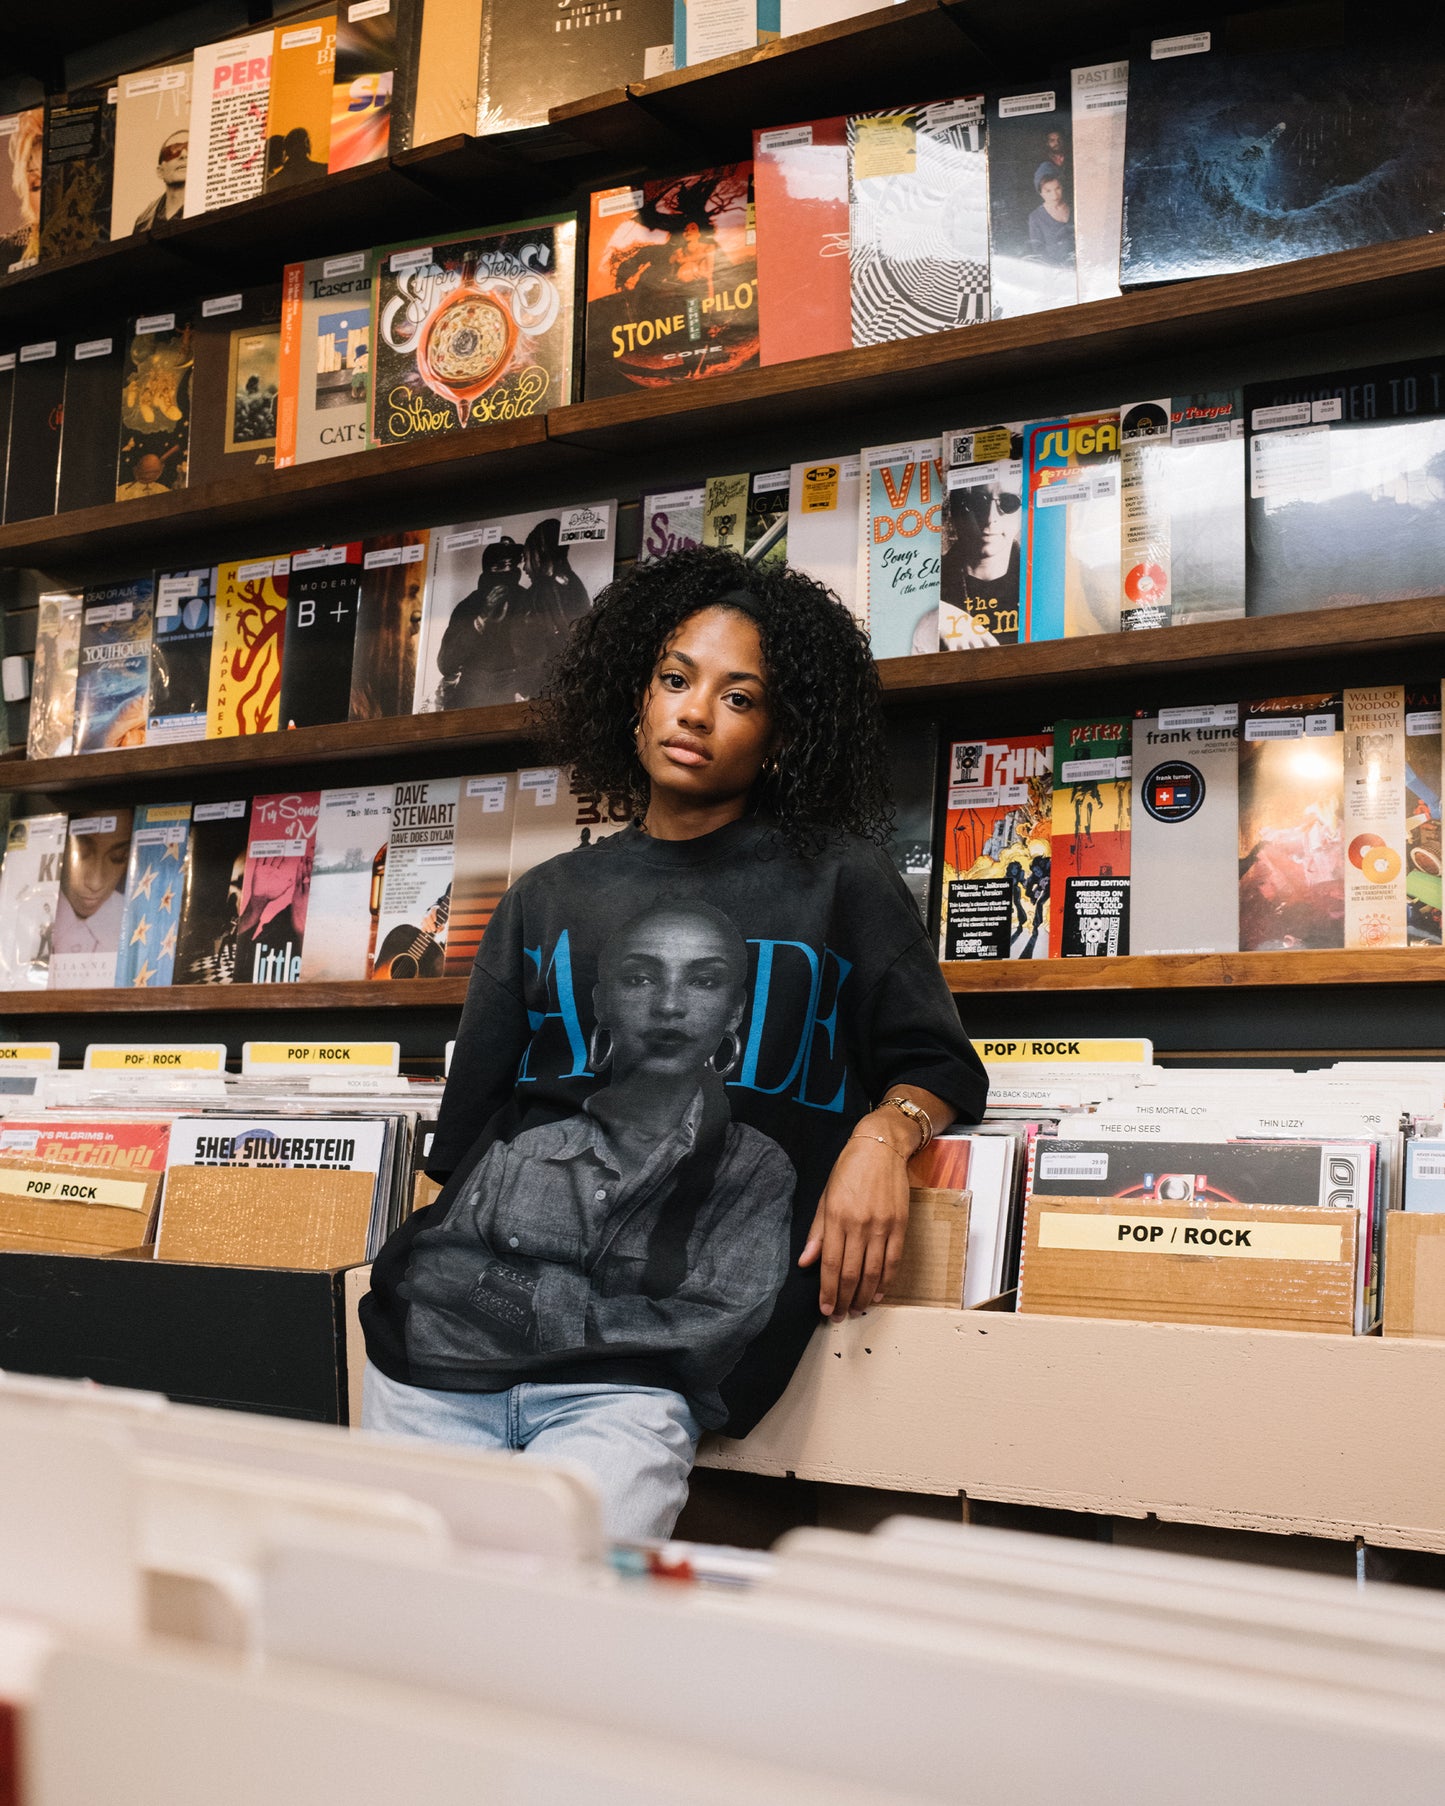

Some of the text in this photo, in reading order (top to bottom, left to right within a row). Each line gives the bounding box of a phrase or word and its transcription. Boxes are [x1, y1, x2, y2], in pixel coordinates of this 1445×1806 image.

[1077, 69, 1108, 85] PAST
[309, 278, 353, 300] Teaser
[611, 314, 686, 359] STONE
[662, 345, 723, 361] CORE
[1388, 376, 1417, 416] TO
[388, 385, 454, 438] Silver
[1186, 403, 1233, 419] Target
[320, 425, 352, 445] CAT
[1039, 424, 1120, 461] SUGA
[881, 547, 919, 569] Songs
[300, 577, 358, 591] MODERN
[892, 565, 914, 589] for
[225, 571, 237, 622] HALF
[964, 597, 998, 612] the
[297, 600, 316, 628] B
[945, 606, 1018, 640] rem
[1349, 691, 1398, 702] WALL OF
[1347, 700, 1400, 712] VOODOO
[1348, 720, 1401, 731] TAPES LIVE
[1351, 712, 1398, 723] THE LOST
[1069, 723, 1123, 748] PETER
[1146, 726, 1240, 745] frank turne
[1201, 747, 1227, 755] NEGATIVE
[980, 744, 1054, 787] THIN
[395, 784, 429, 807] DAVE
[346, 808, 361, 817] The
[393, 803, 456, 827] STEWART
[391, 829, 455, 845] DAVE DOES DYLAN
[951, 882, 1010, 891] Thin Lizzy Jailbreak
[956, 889, 1003, 898] Alternate Version
[1076, 890, 1110, 898] PRESSED
[1074, 902, 1101, 910] GREEN,
[955, 945, 989, 954] STORE DAY
[956, 939, 982, 947] RECORD
[253, 941, 302, 984] little
[288, 1048, 310, 1060] POP
[318, 1048, 351, 1060] ROCK
[984, 1042, 1017, 1056] POP
[1032, 1041, 1081, 1056] ROCK
[125, 1054, 182, 1065] POP ROCK
[1002, 1090, 1022, 1099] BACK
[1022, 1090, 1051, 1100] SUNDAY
[1136, 1105, 1189, 1116] THIS MORTAL
[1100, 1124, 1161, 1134] THEE OH SEES
[1259, 1119, 1305, 1129] THIN LIZZY
[55, 1131, 114, 1141] PILGRIMS in
[195, 1136, 356, 1162] SHEL SILVERSTEIN
[26, 1180, 52, 1194] POP
[60, 1184, 98, 1199] ROCK
[1117, 1225, 1164, 1242] POP
[1183, 1227, 1252, 1247] ROCK
